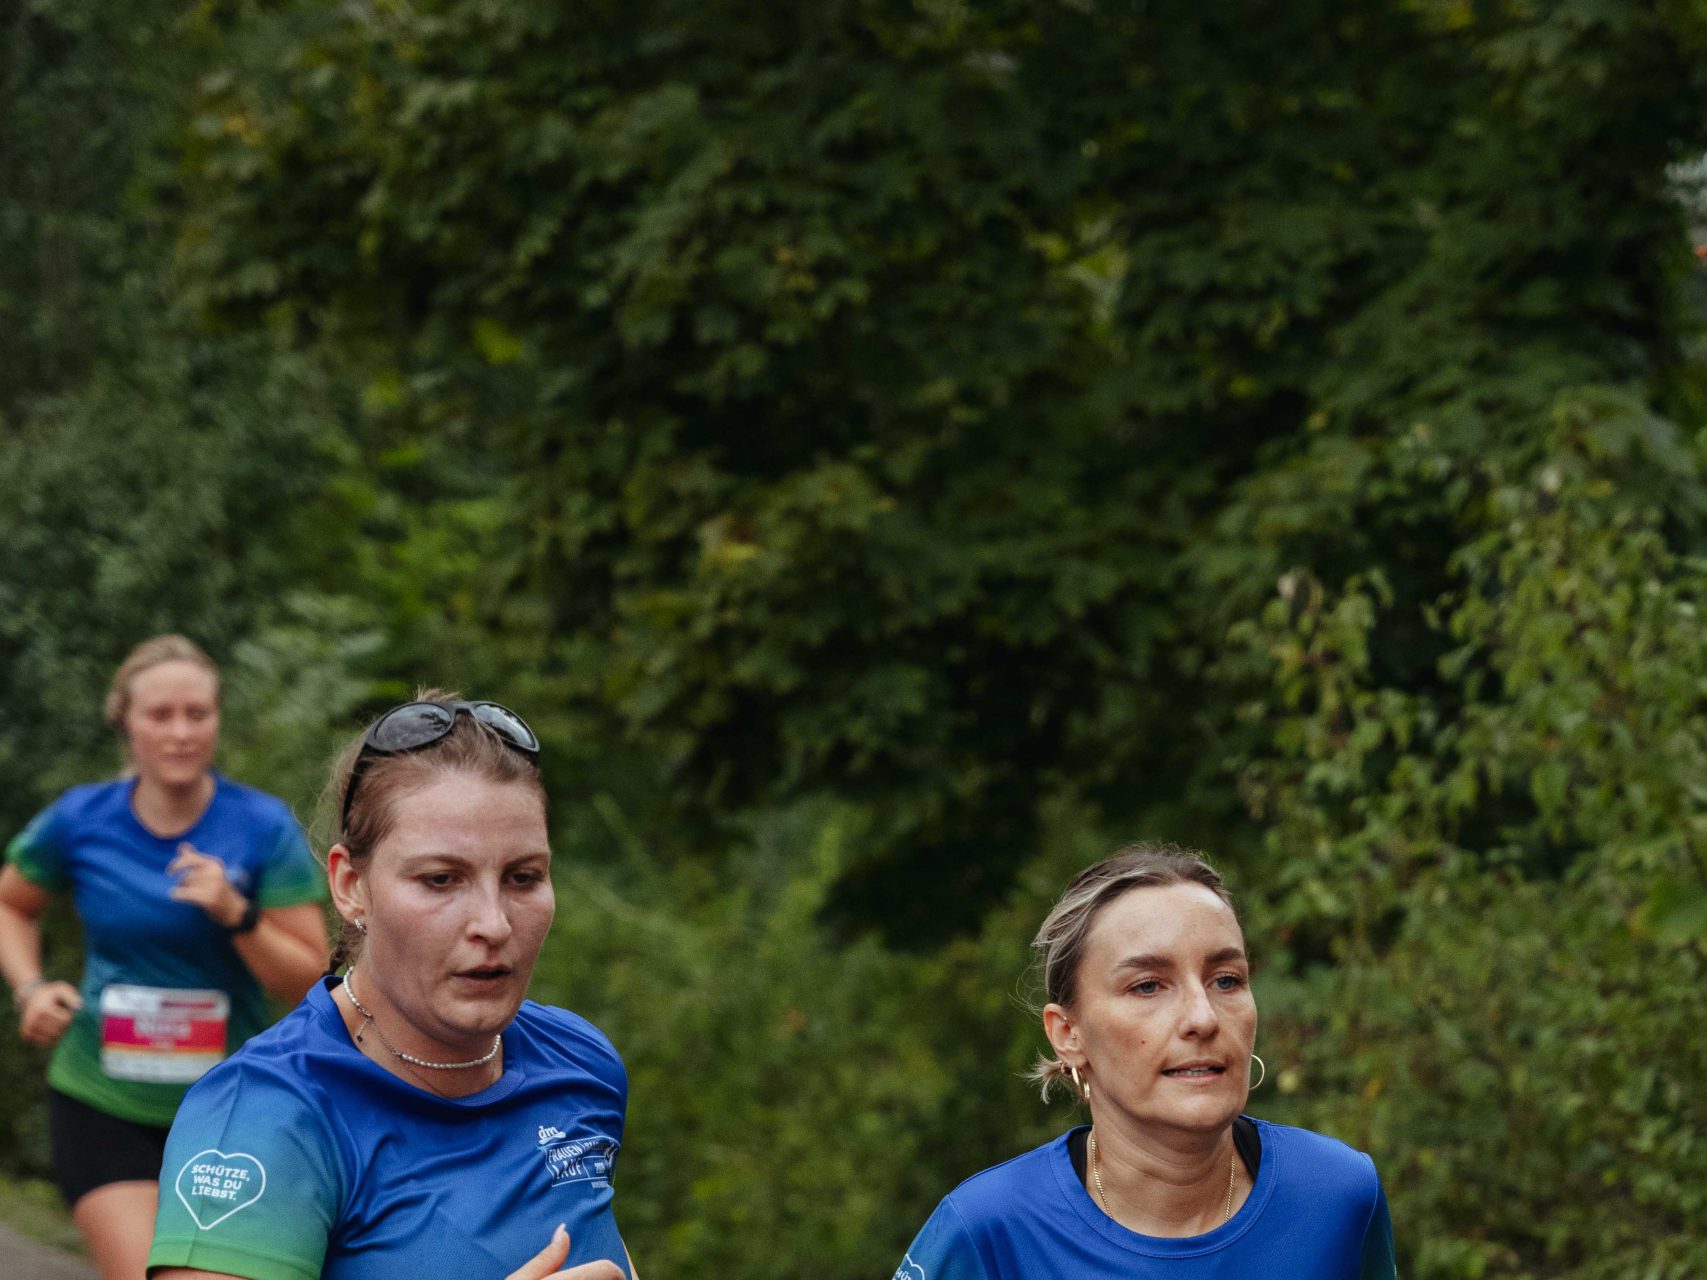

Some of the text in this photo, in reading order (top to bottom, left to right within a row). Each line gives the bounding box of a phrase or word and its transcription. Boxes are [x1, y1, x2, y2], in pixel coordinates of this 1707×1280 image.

[191, 1164, 250, 1181] SCHÜTZE,
[193, 1175, 242, 1190] WAS DU
[191, 1185, 237, 1200] LIEBST.
